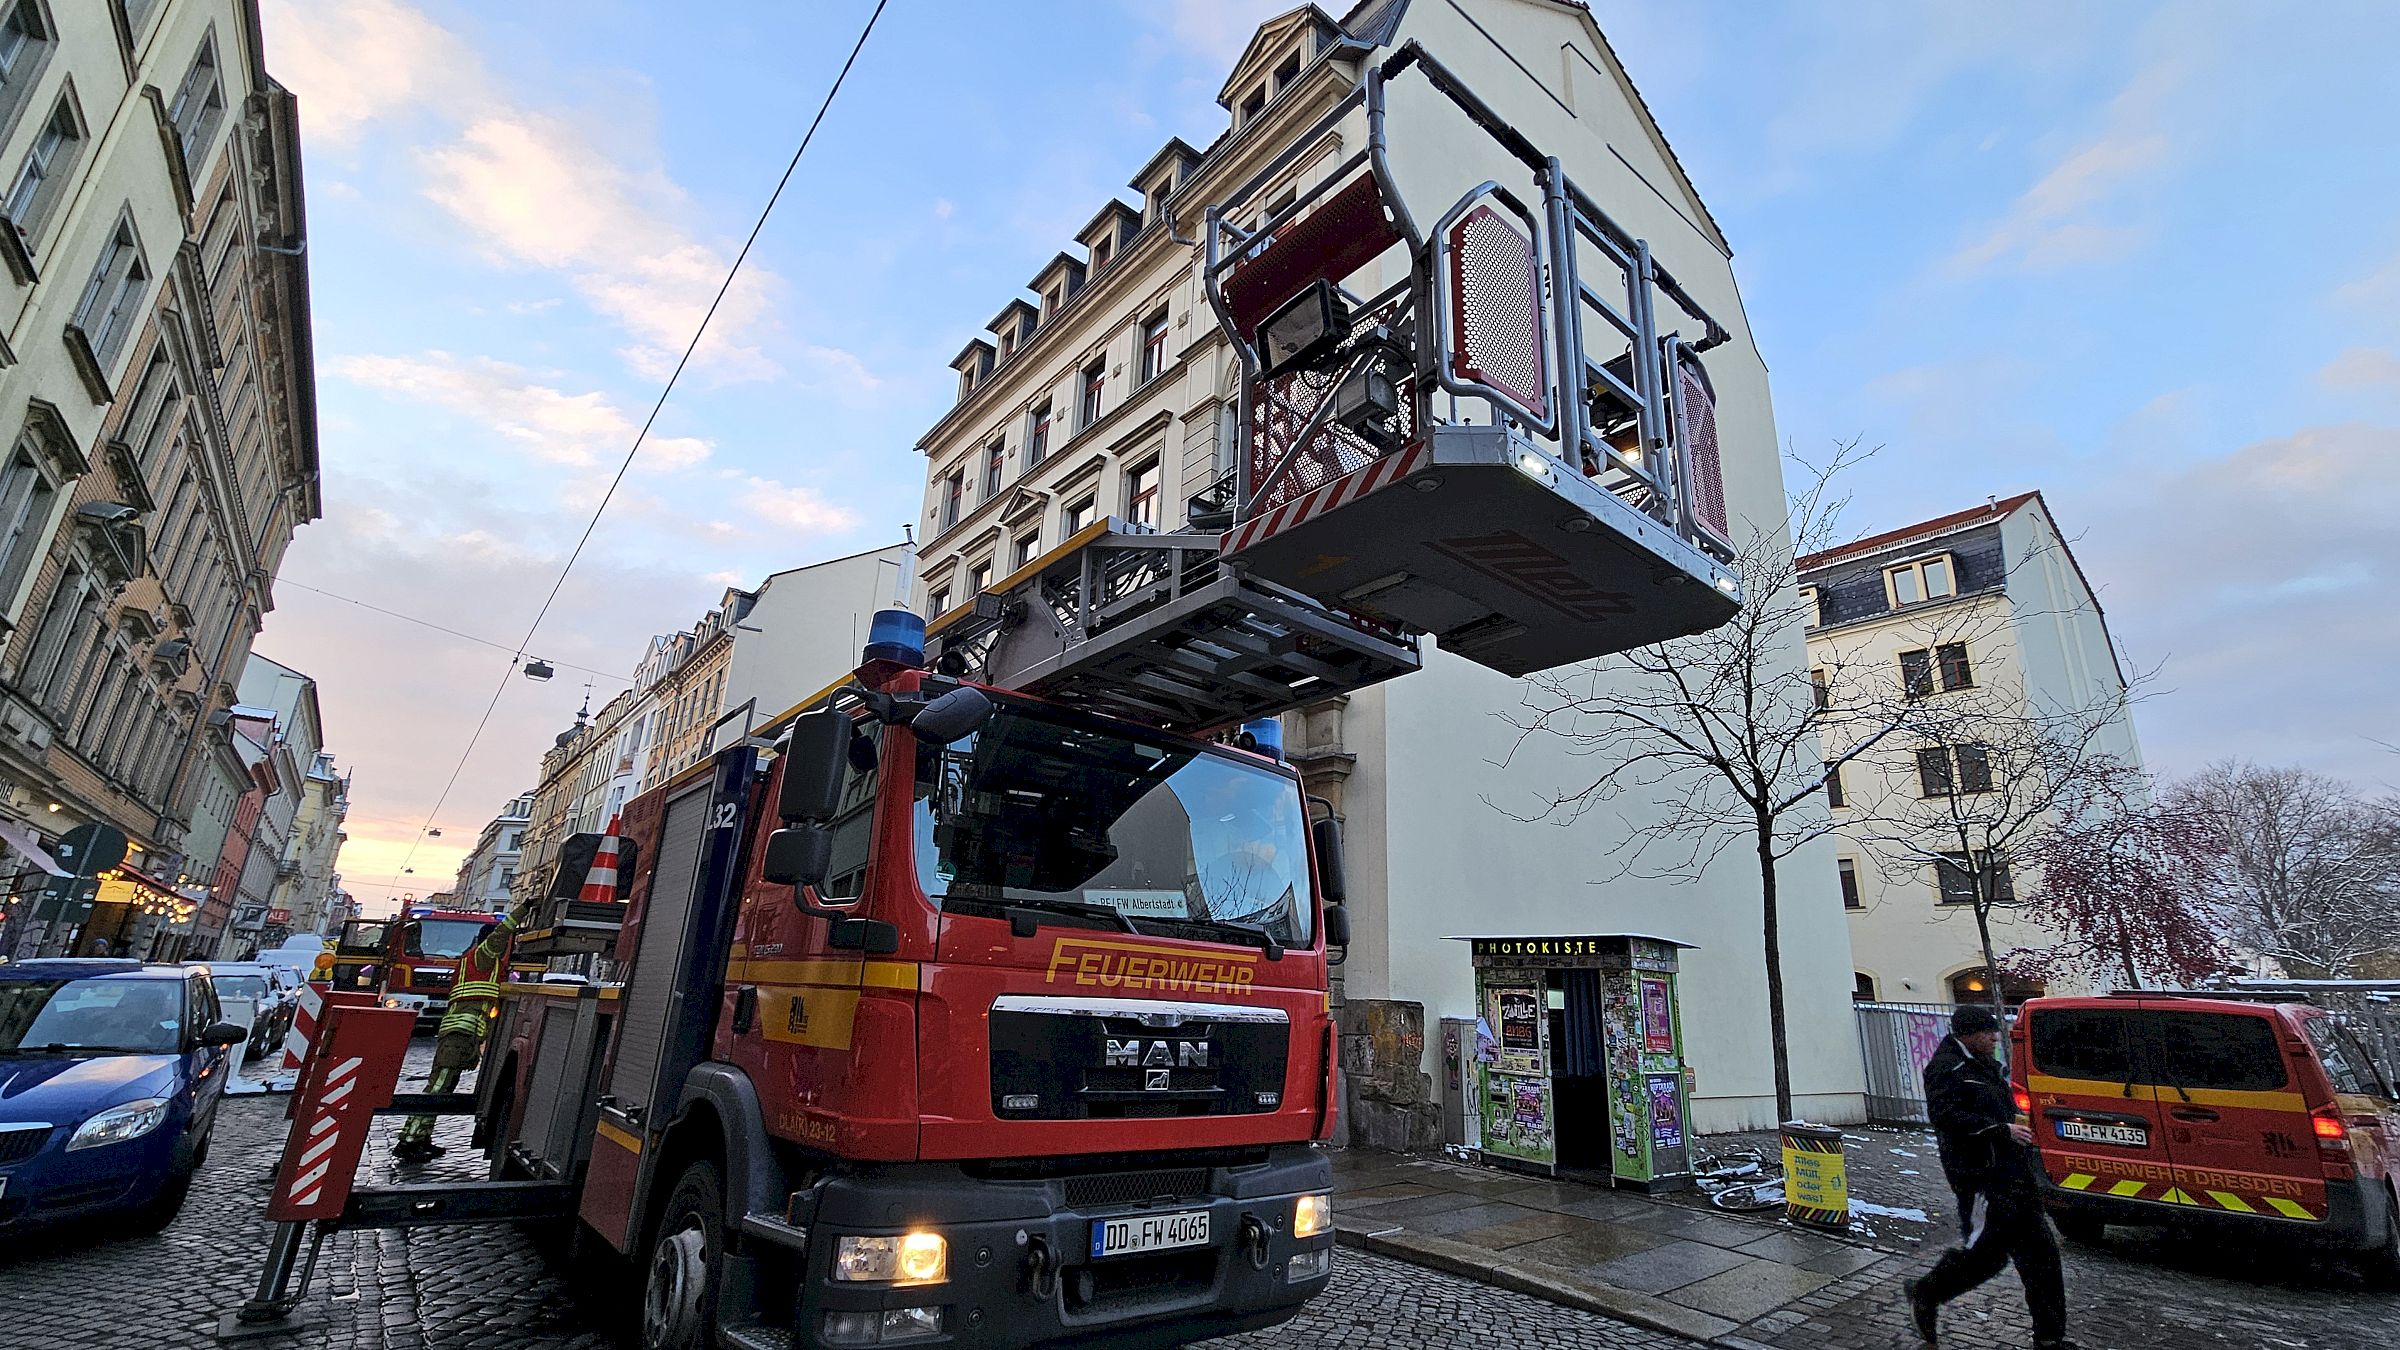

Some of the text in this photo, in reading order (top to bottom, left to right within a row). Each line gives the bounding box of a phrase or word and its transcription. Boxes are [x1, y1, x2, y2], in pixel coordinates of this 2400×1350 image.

[1132, 898, 1175, 910] Albertstadt
[267, 911, 285, 920] ALE
[1478, 941, 1596, 954] PHOTOKISTE
[1046, 937, 1257, 995] FEUERWEHR
[1105, 1039, 1208, 1067] MAN
[809, 1121, 836, 1142] 23-12
[2064, 1123, 2144, 1142] DD FW 4135
[2064, 1155, 2303, 1196] FEUERWEHR DRESDEN
[1105, 1215, 1207, 1251] DD FW 4065
